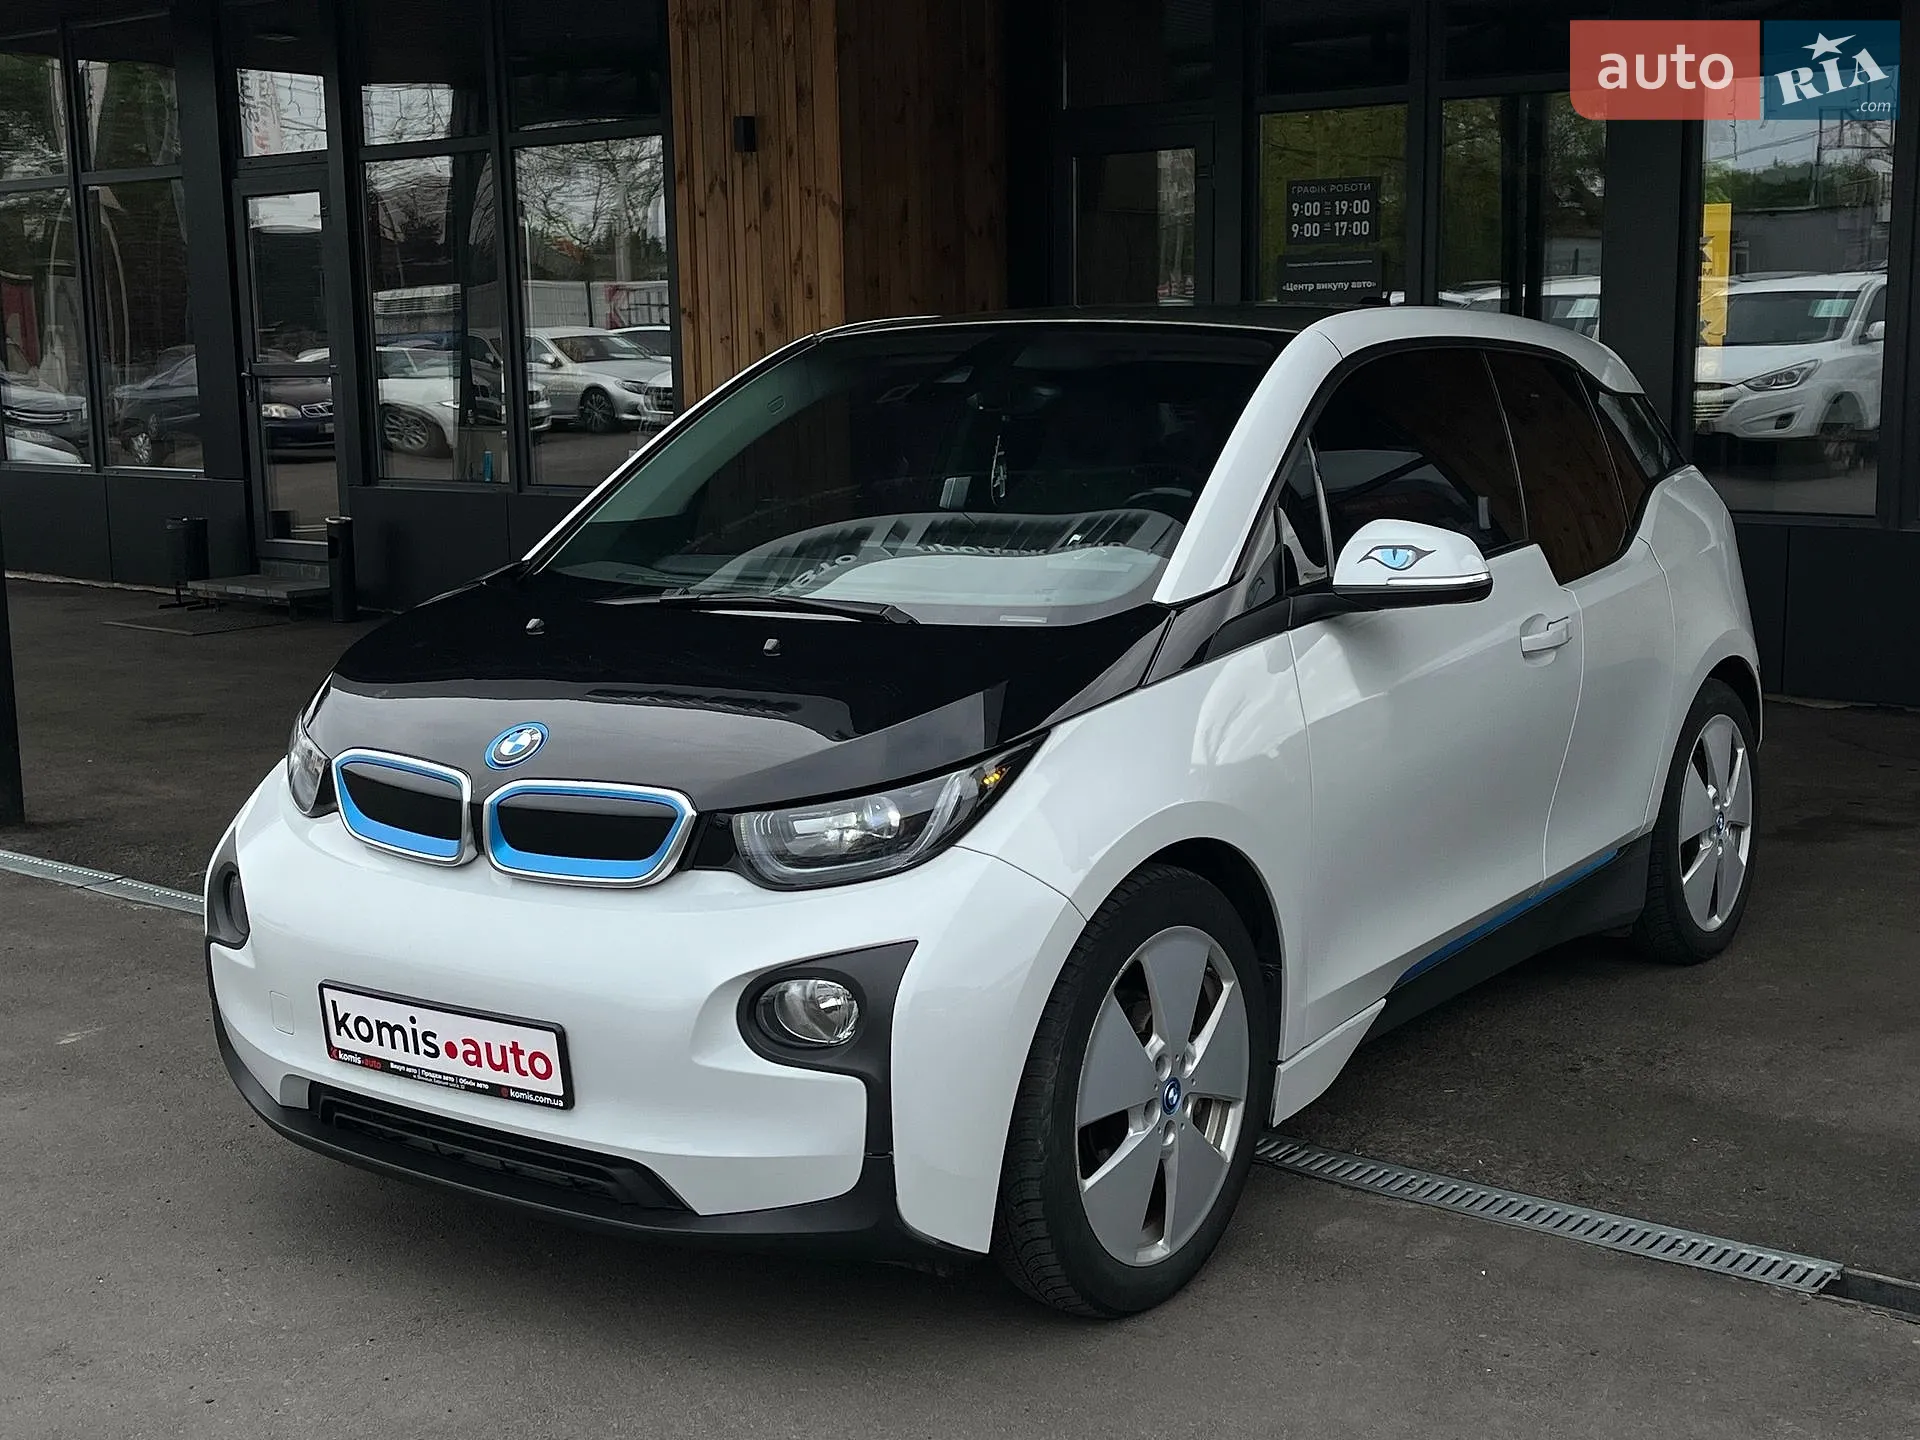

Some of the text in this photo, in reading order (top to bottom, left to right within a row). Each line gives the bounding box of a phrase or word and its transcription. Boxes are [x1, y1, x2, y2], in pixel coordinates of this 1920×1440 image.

[1291, 182, 1371, 195] ГРАФІК РОБОТИ
[1291, 201, 1321, 217] 9:00
[1334, 199, 1370, 215] 19:00
[1291, 221, 1370, 238] 9:00 17:00
[1282, 282, 1315, 293] «Центр
[1316, 281, 1350, 291] викупу
[509, 1088, 564, 1107] komis.com.ua
